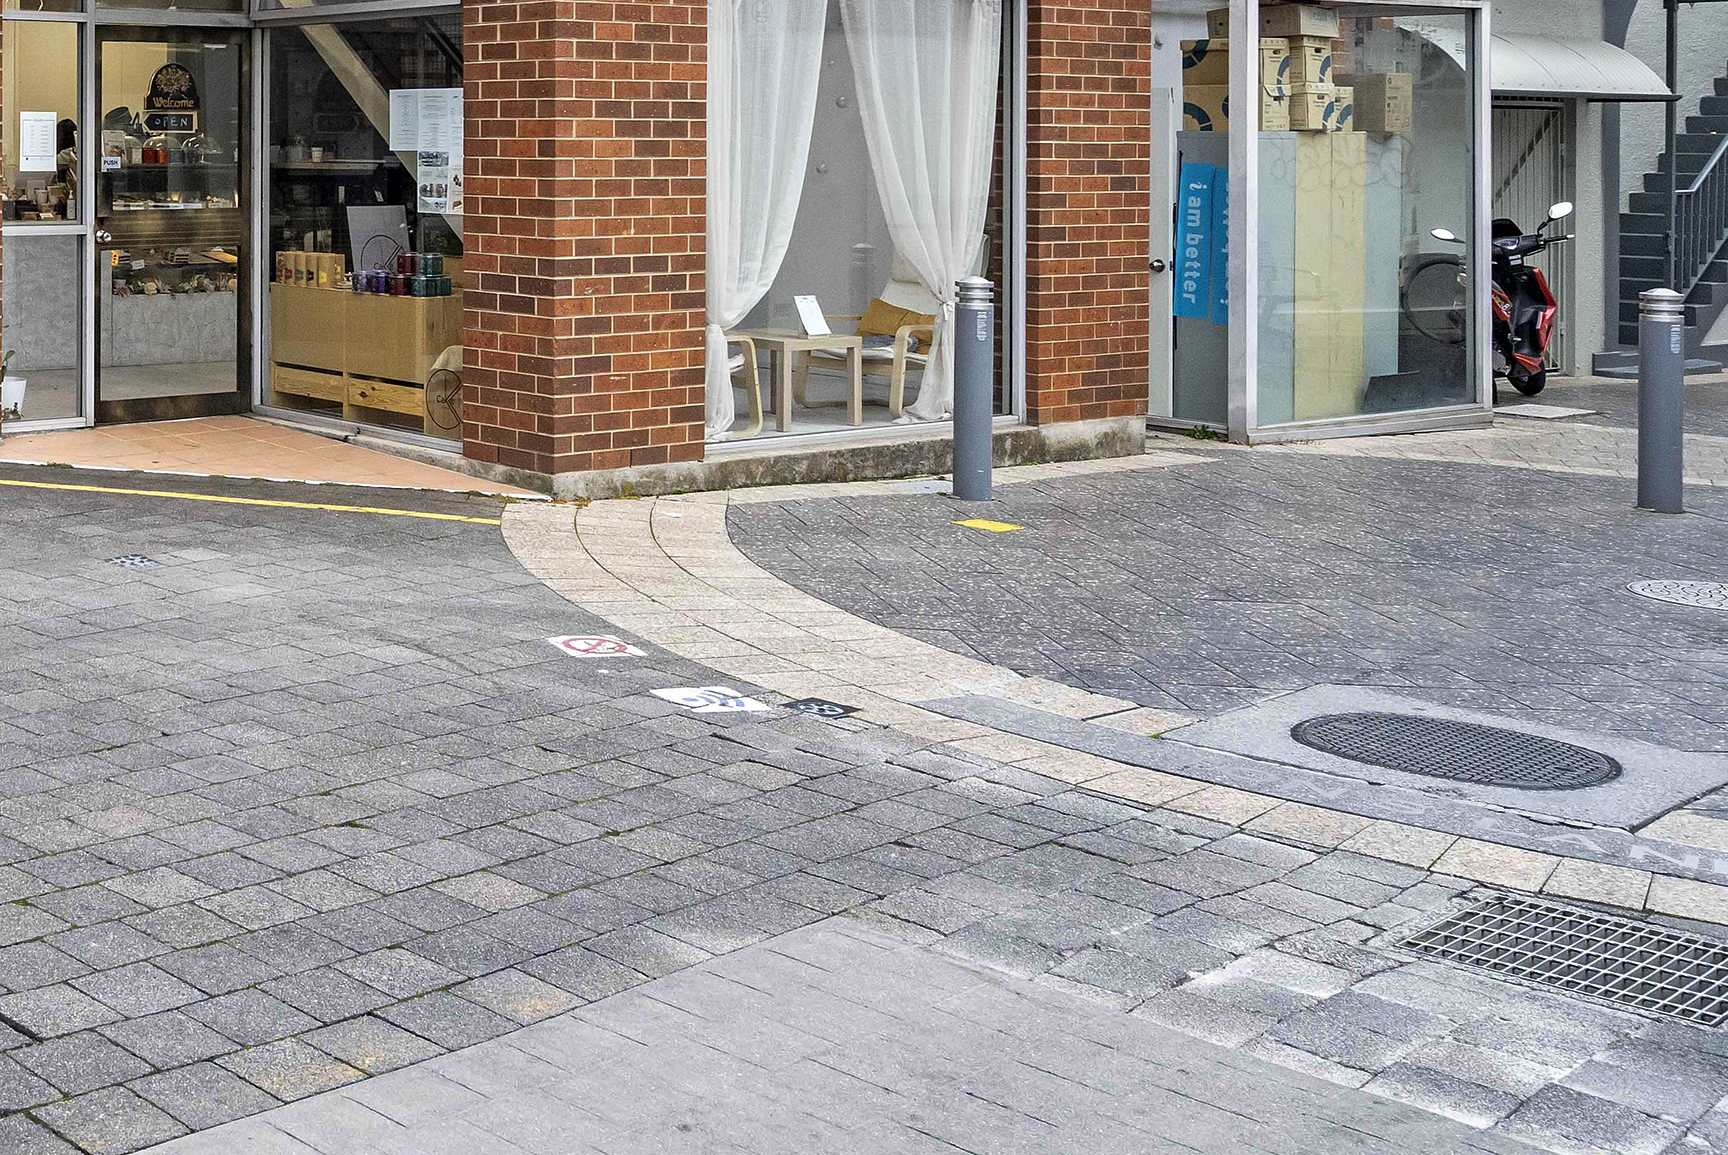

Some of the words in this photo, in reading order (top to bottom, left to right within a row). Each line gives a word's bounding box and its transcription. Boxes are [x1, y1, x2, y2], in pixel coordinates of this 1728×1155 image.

[152, 96, 195, 108] Welcome
[154, 116, 188, 127] OPEN
[1186, 196, 1202, 227] am
[1182, 232, 1204, 304] better
